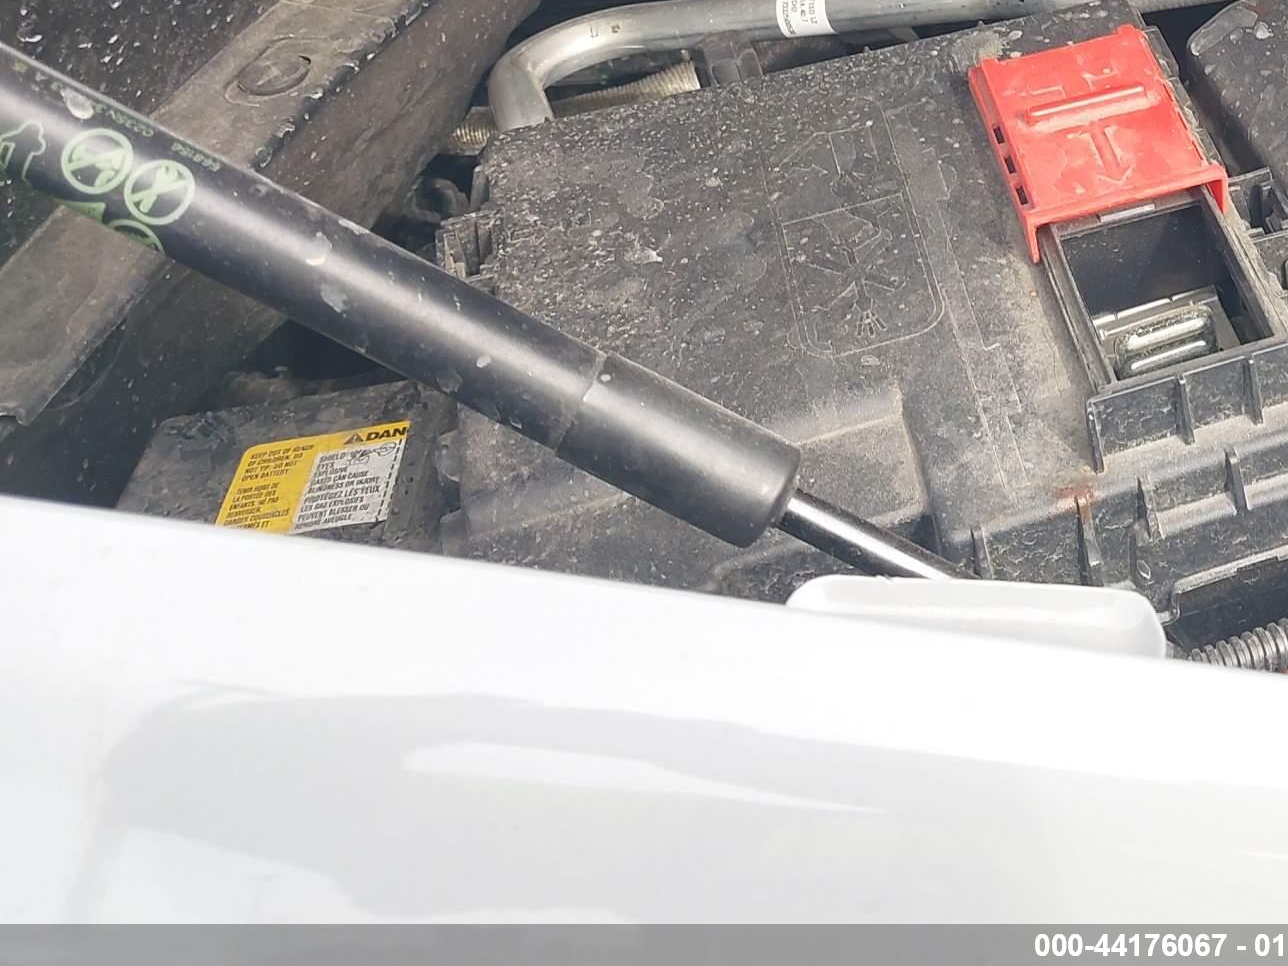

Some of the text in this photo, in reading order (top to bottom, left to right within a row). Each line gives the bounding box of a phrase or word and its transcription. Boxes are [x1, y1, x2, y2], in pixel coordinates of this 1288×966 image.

[268, 449, 281, 458] OUT
[320, 452, 346, 462] SHIELD
[333, 474, 347, 482] CAN
[347, 470, 369, 479] CAUSE
[360, 485, 380, 494] YEUX
